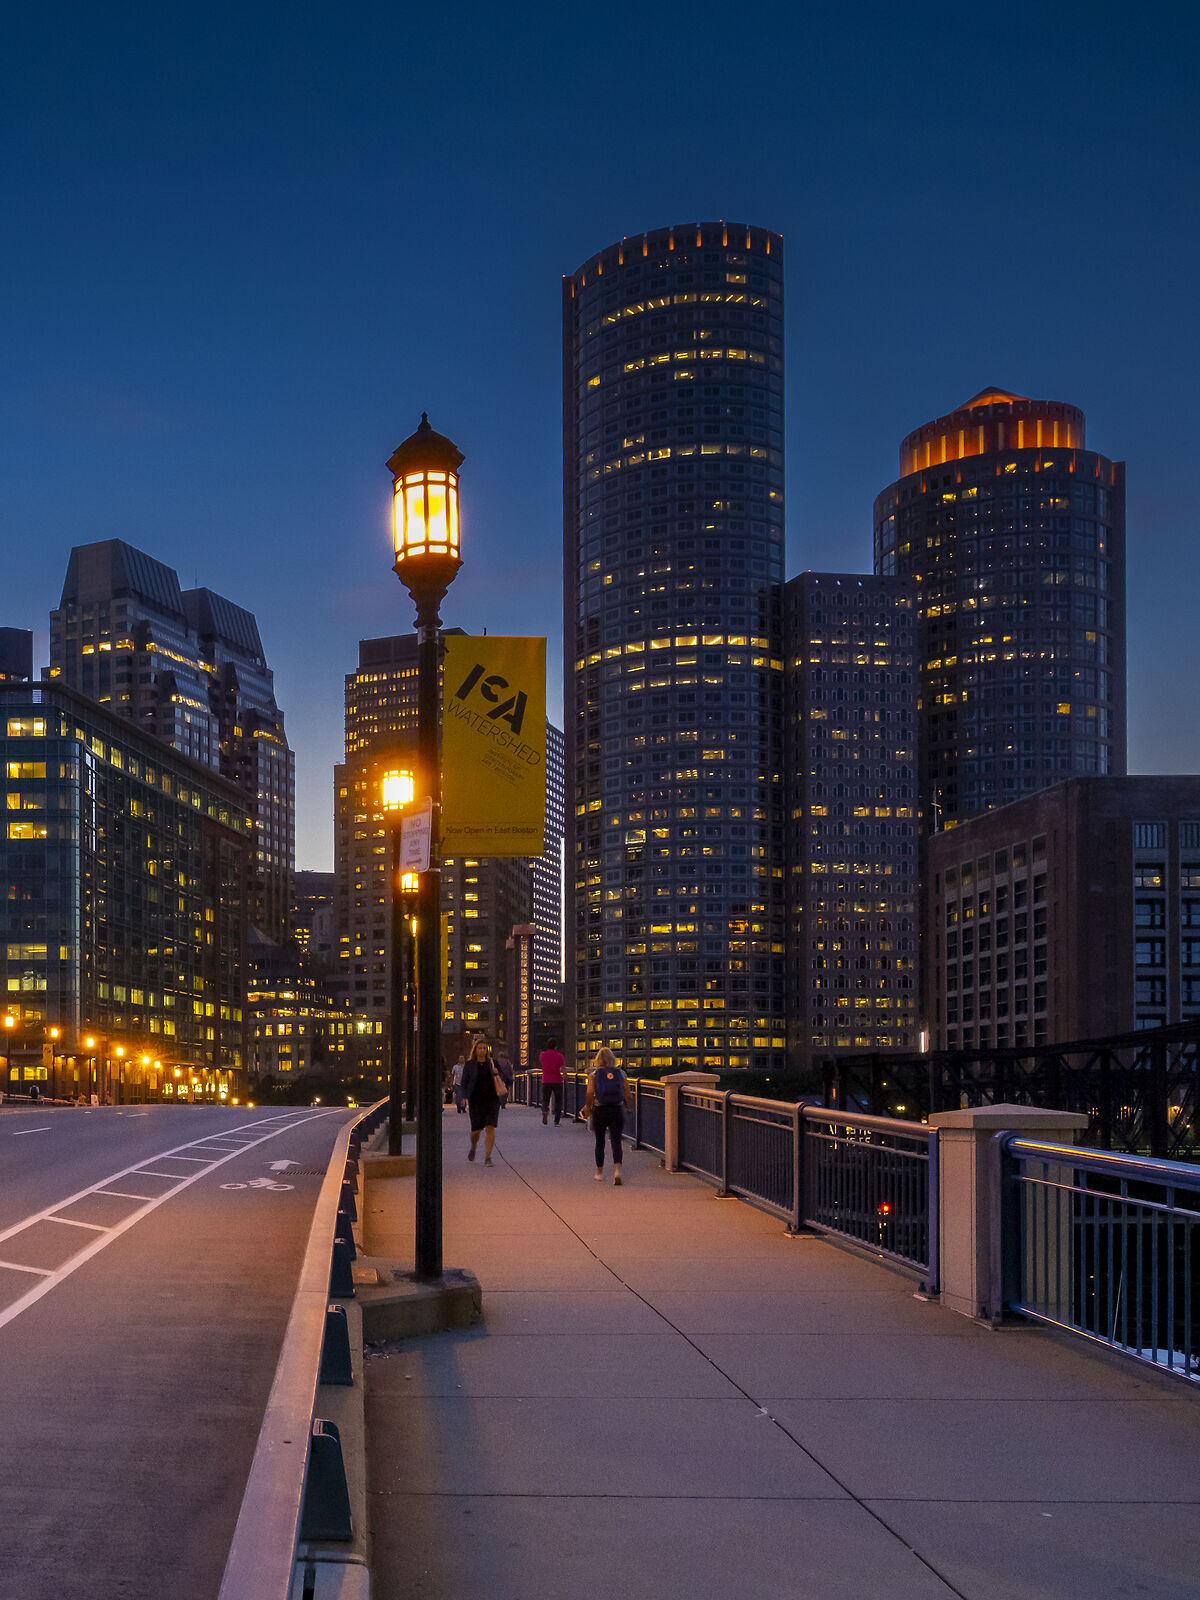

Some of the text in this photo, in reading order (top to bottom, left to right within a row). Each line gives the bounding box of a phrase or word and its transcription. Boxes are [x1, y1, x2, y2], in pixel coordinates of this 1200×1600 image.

[447, 698, 541, 766] WATERSHED
[455, 663, 528, 735] ICA
[445, 826, 539, 836] Now Open in East Boston
